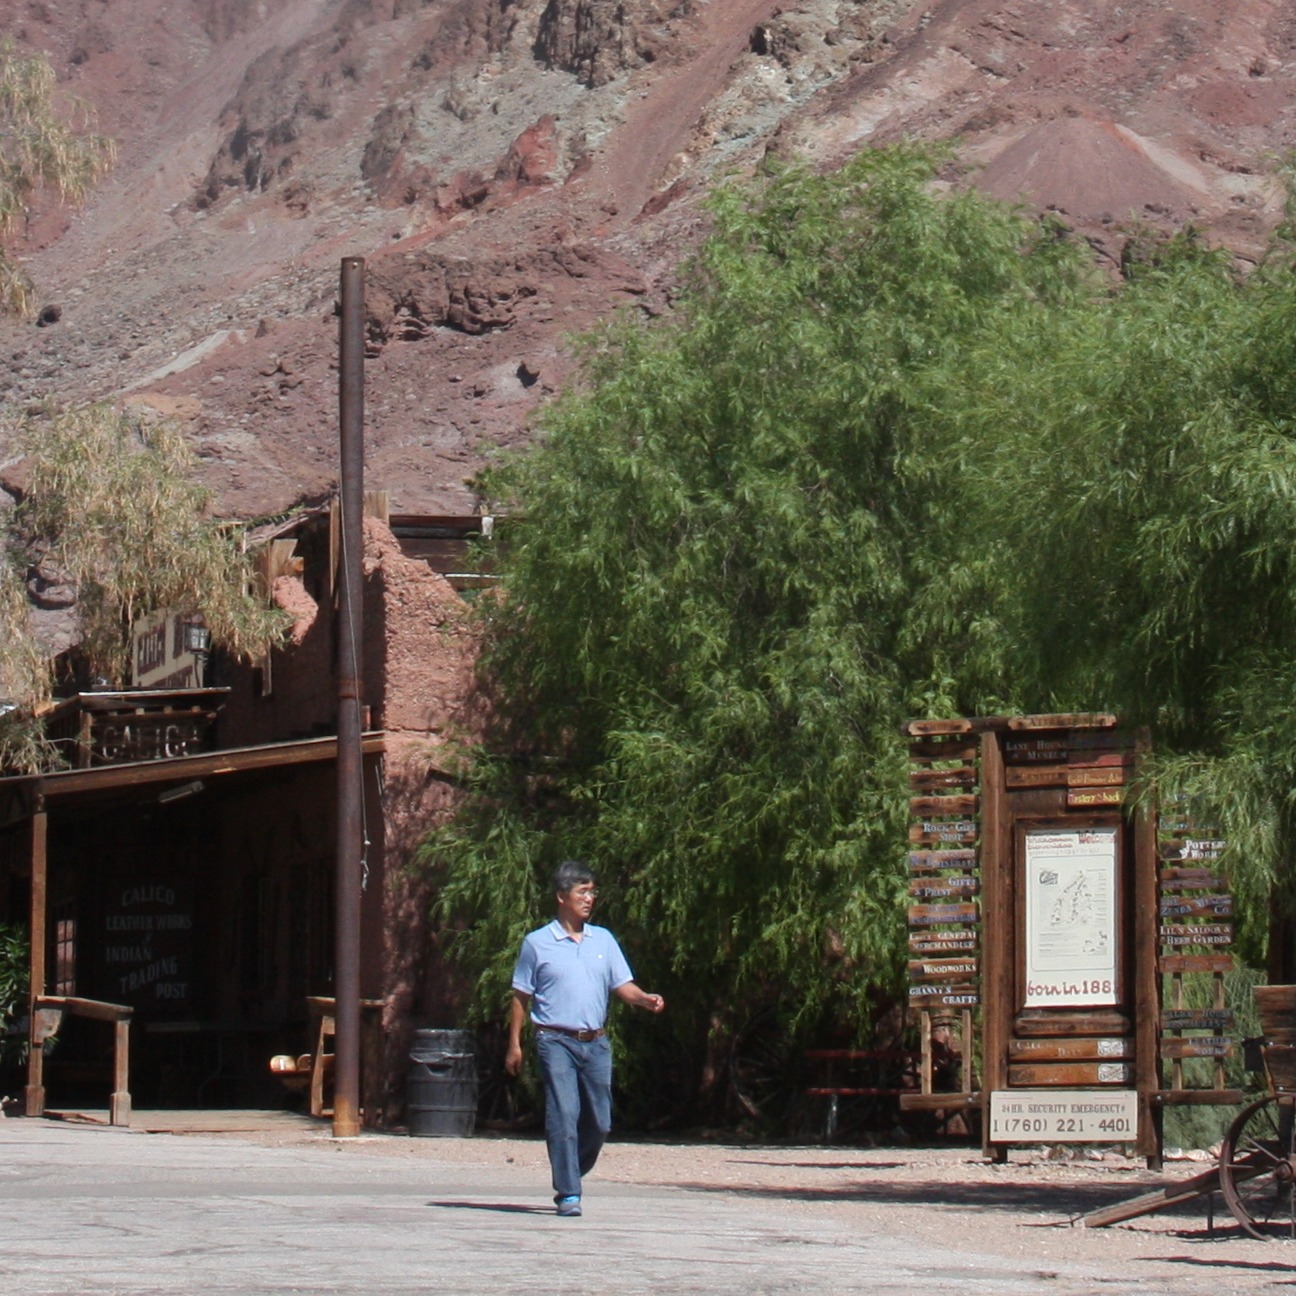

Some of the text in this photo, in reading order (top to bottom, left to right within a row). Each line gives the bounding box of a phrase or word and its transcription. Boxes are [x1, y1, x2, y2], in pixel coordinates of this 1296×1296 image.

[121, 886, 175, 907] CALICO
[105, 914, 192, 930] LEATHER WORKS
[1186, 926, 1221, 935] SALOON
[1166, 934, 1232, 945] BEER GARDEN
[105, 946, 152, 962] INDIAN
[119, 956, 178, 994] TRADING
[922, 964, 977, 973] WOODWORKS
[155, 983, 187, 998] POST
[909, 986, 952, 996] GRANNY'S
[1027, 980, 1114, 996] born in 188
[942, 996, 978, 1005] CRAFTS
[1028, 1103, 1067, 1113] SECURITY
[993, 1119, 999, 1132] 1
[1004, 1118, 1047, 1132] (760)
[1057, 1119, 1085, 1132] 221
[1098, 1118, 1130, 1132] 4401
